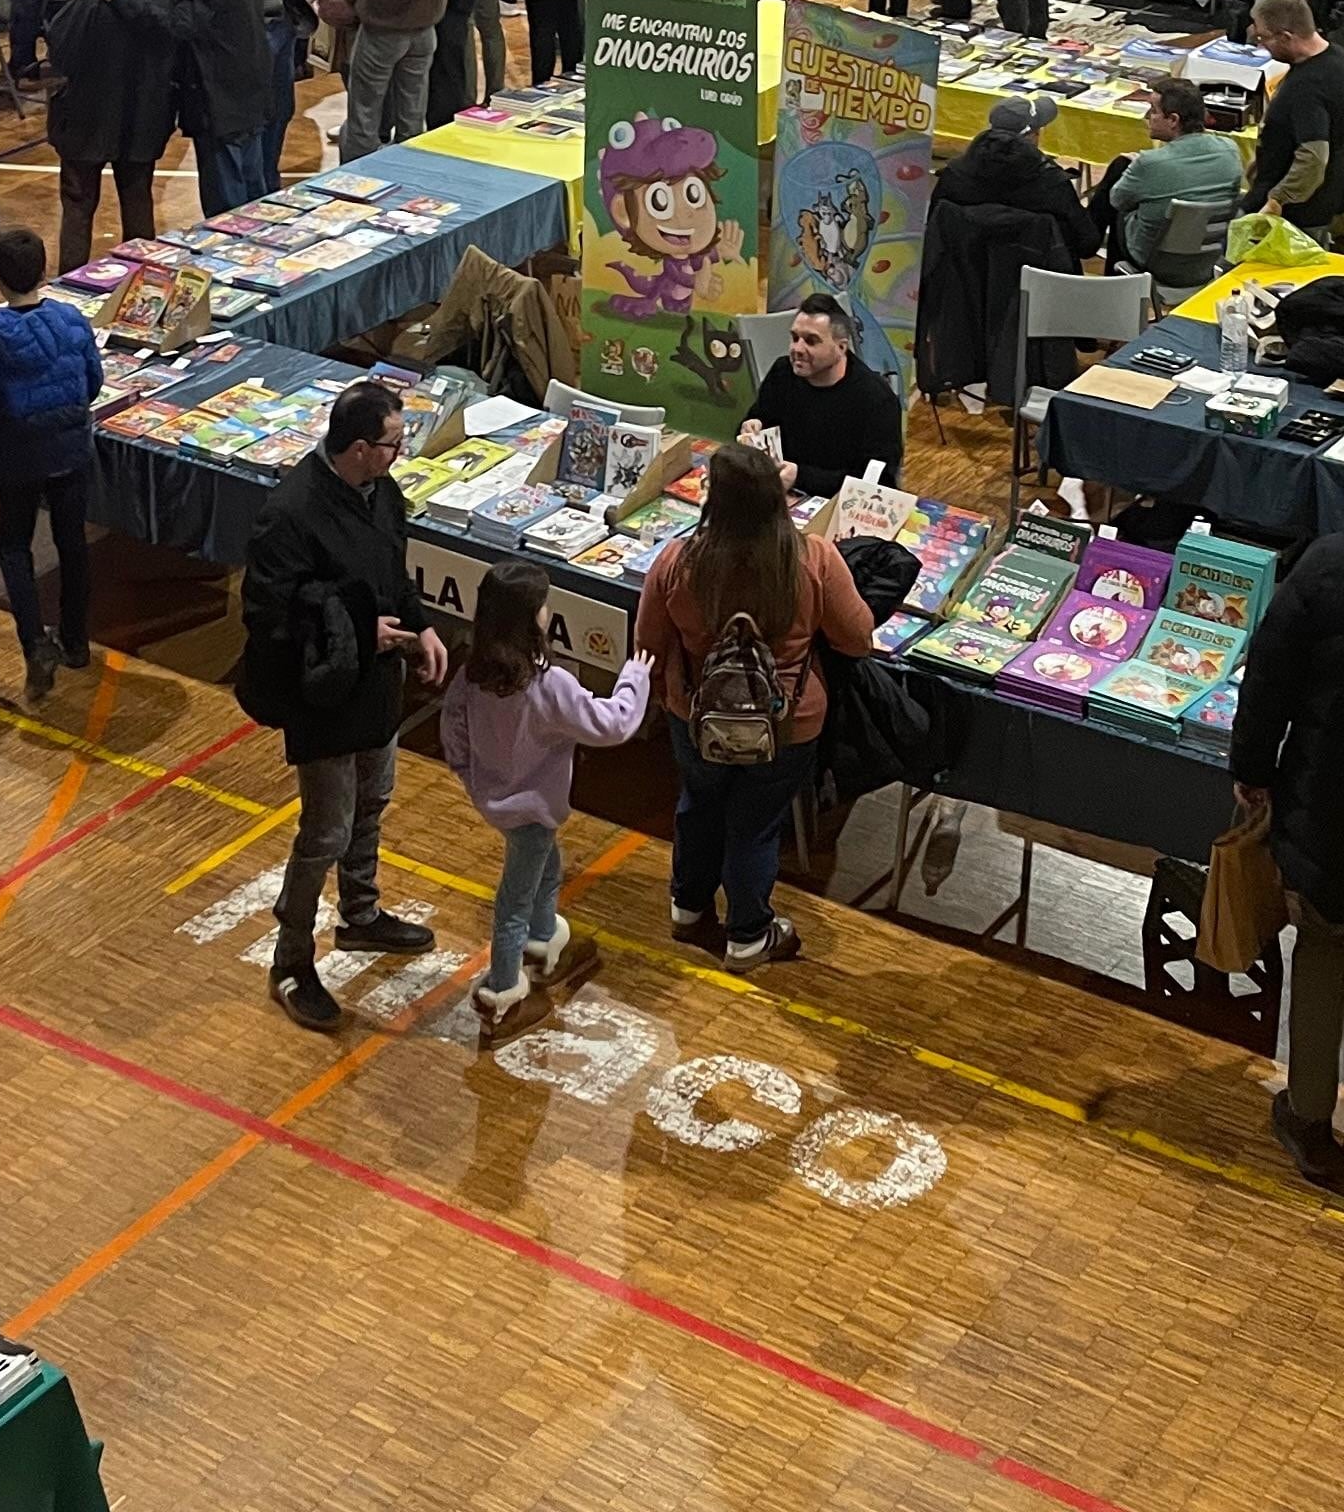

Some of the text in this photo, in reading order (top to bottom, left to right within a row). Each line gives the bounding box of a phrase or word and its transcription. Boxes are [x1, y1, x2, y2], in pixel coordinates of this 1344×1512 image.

[601, 13, 747, 50] ME ENCANTAN LOS
[593, 37, 755, 83] DINOSAURIOS
[785, 38, 921, 104] CUESTIÓN
[821, 82, 931, 131] TIEMPO
[415, 566, 464, 613] LA
